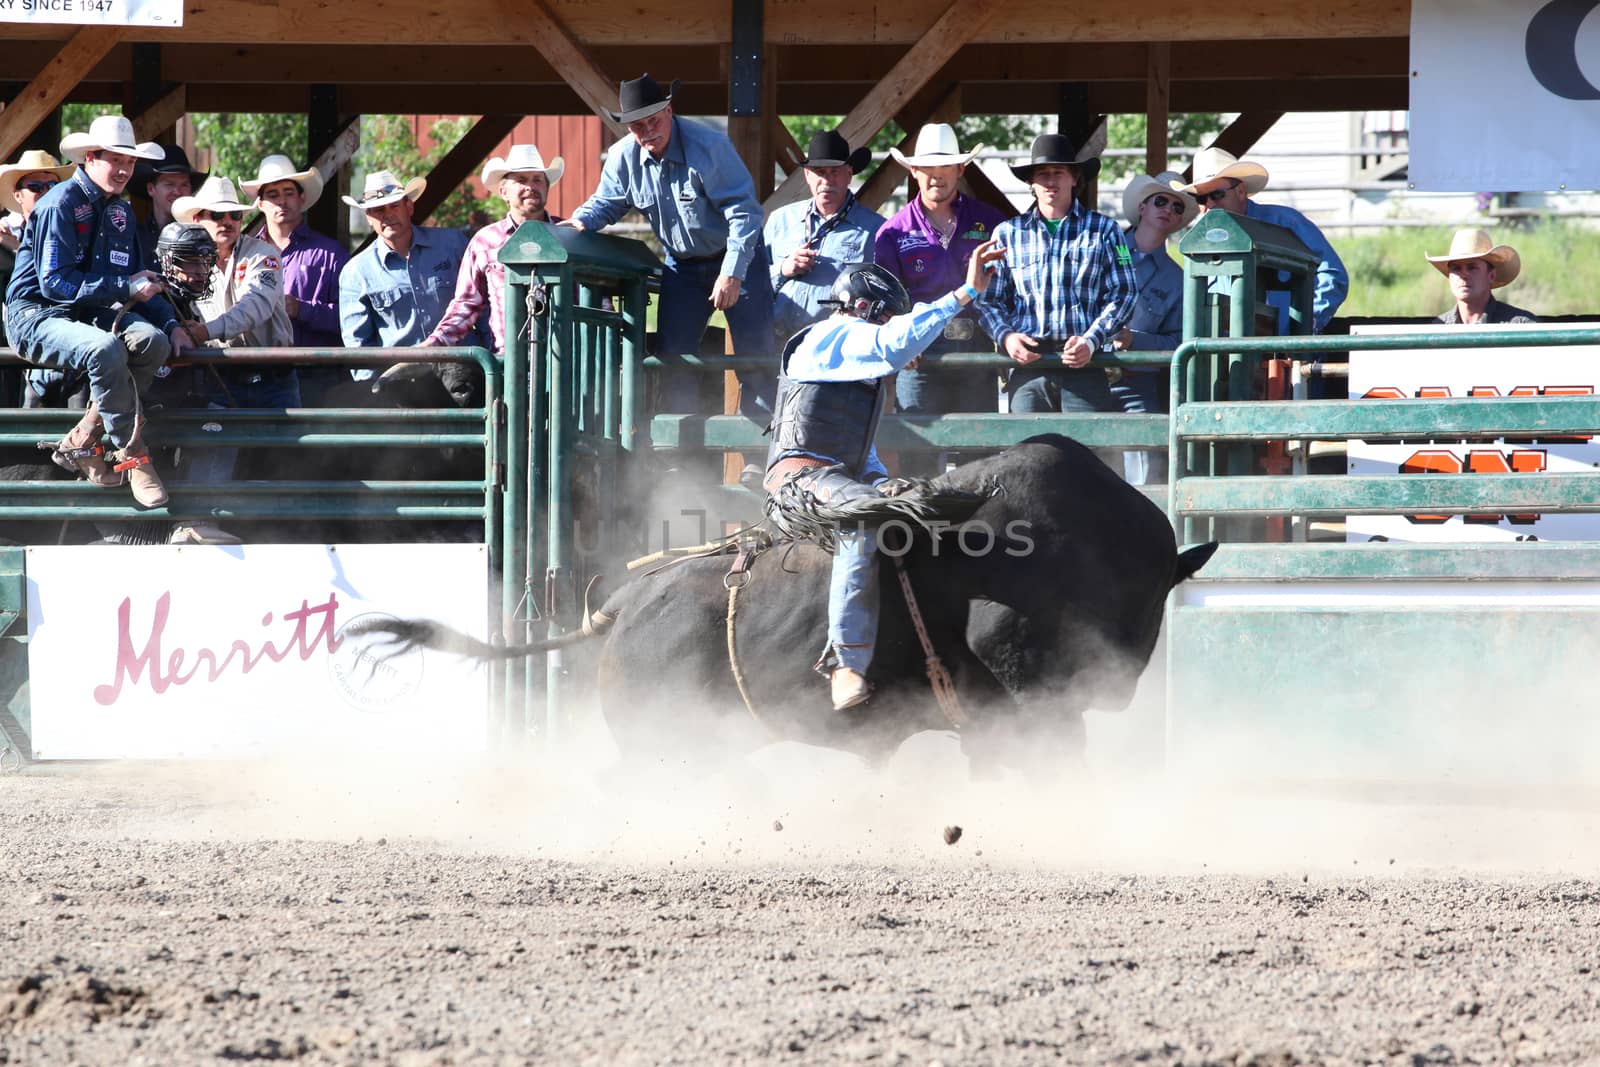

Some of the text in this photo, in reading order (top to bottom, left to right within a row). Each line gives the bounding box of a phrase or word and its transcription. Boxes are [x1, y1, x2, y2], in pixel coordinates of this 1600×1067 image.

[22, 0, 73, 11] SINCE
[80, 0, 113, 12] 1947
[93, 589, 345, 706] Merritt
